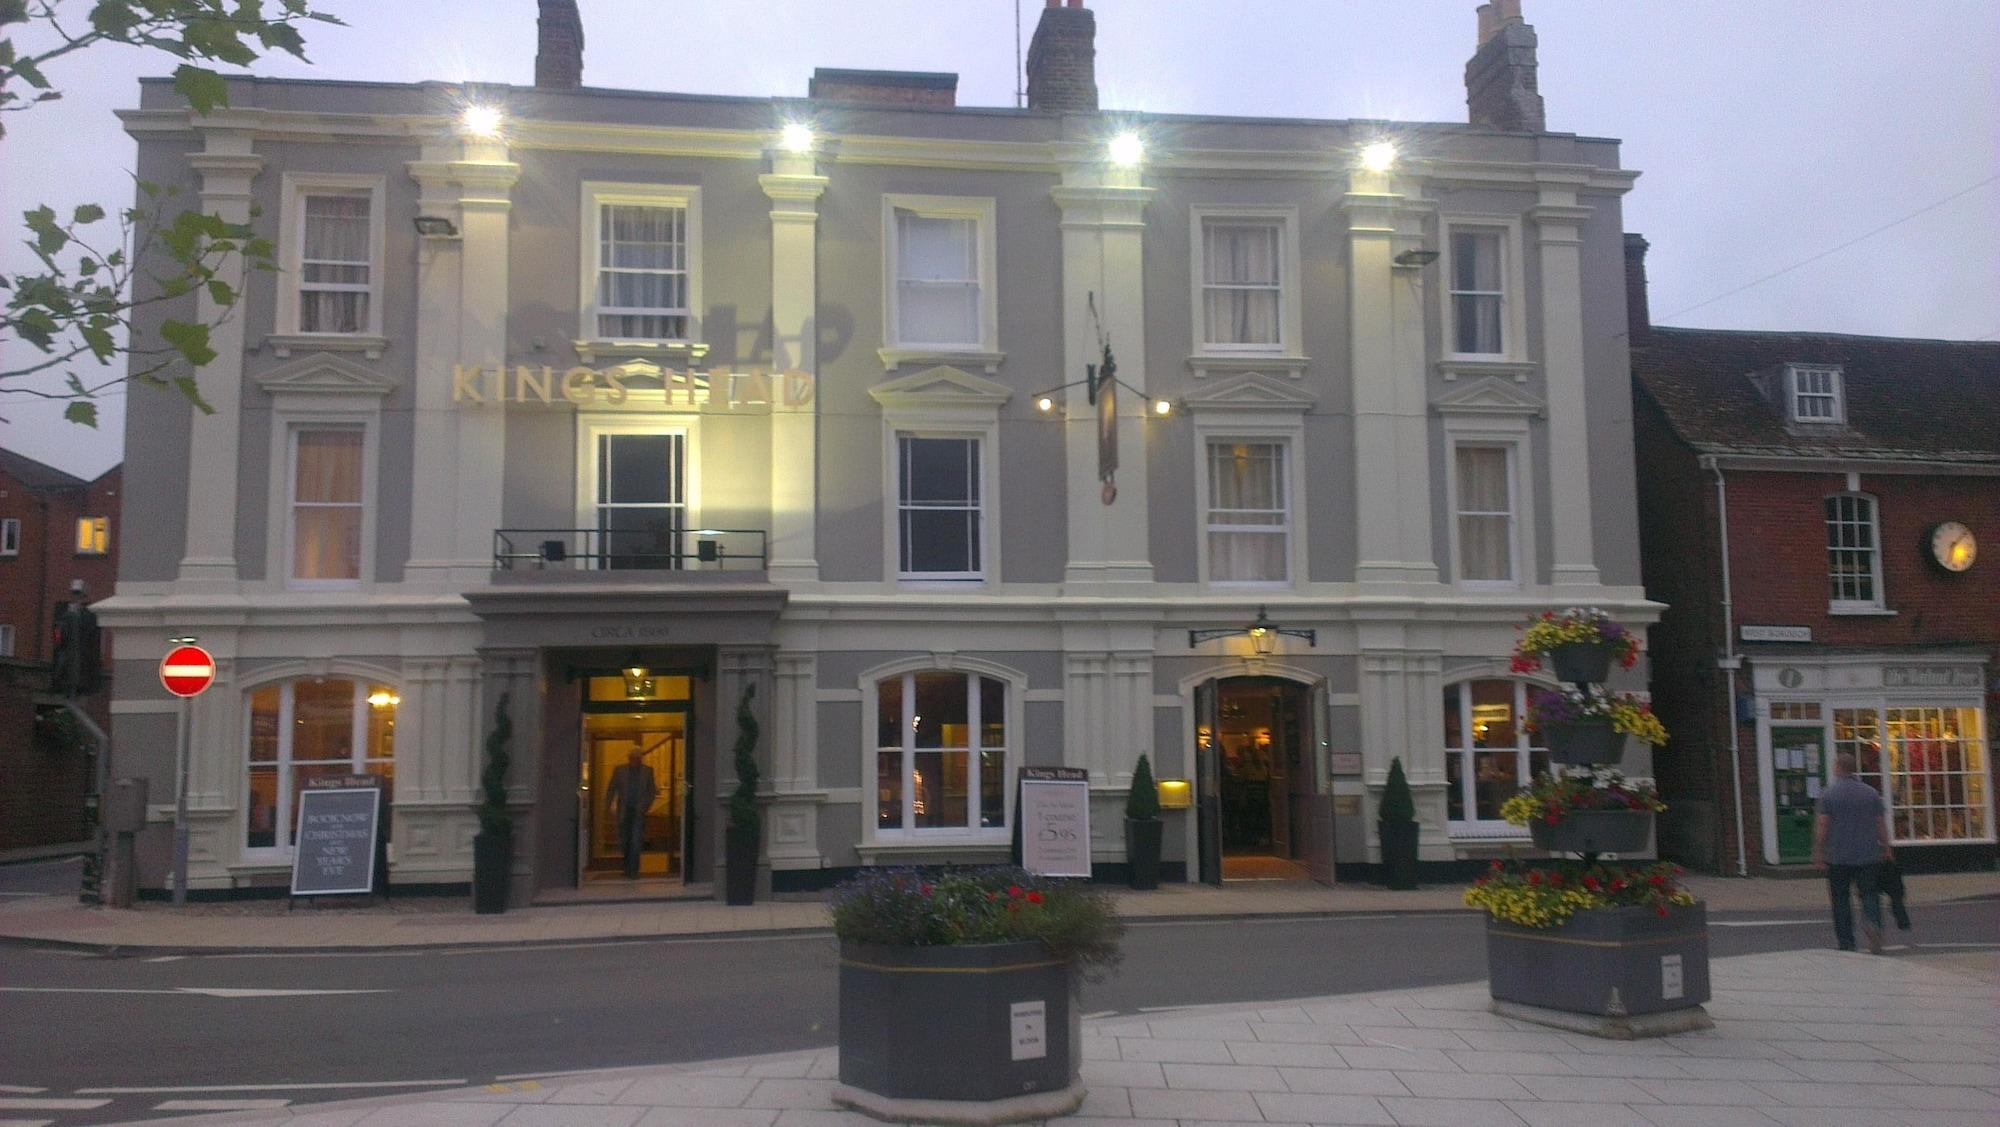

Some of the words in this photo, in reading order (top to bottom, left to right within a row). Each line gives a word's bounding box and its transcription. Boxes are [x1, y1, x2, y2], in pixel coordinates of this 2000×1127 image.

[453, 363, 627, 405] KINGS
[664, 367, 813, 408] HEAD
[1027, 769, 1056, 779] Kings
[1057, 769, 1083, 779] Head
[308, 777, 342, 788] Kings
[345, 776, 375, 786] Head
[307, 815, 339, 824] BOOK
[341, 813, 369, 823] NOW
[305, 829, 369, 840] CHRISTMAS
[322, 846, 348, 856] NEW
